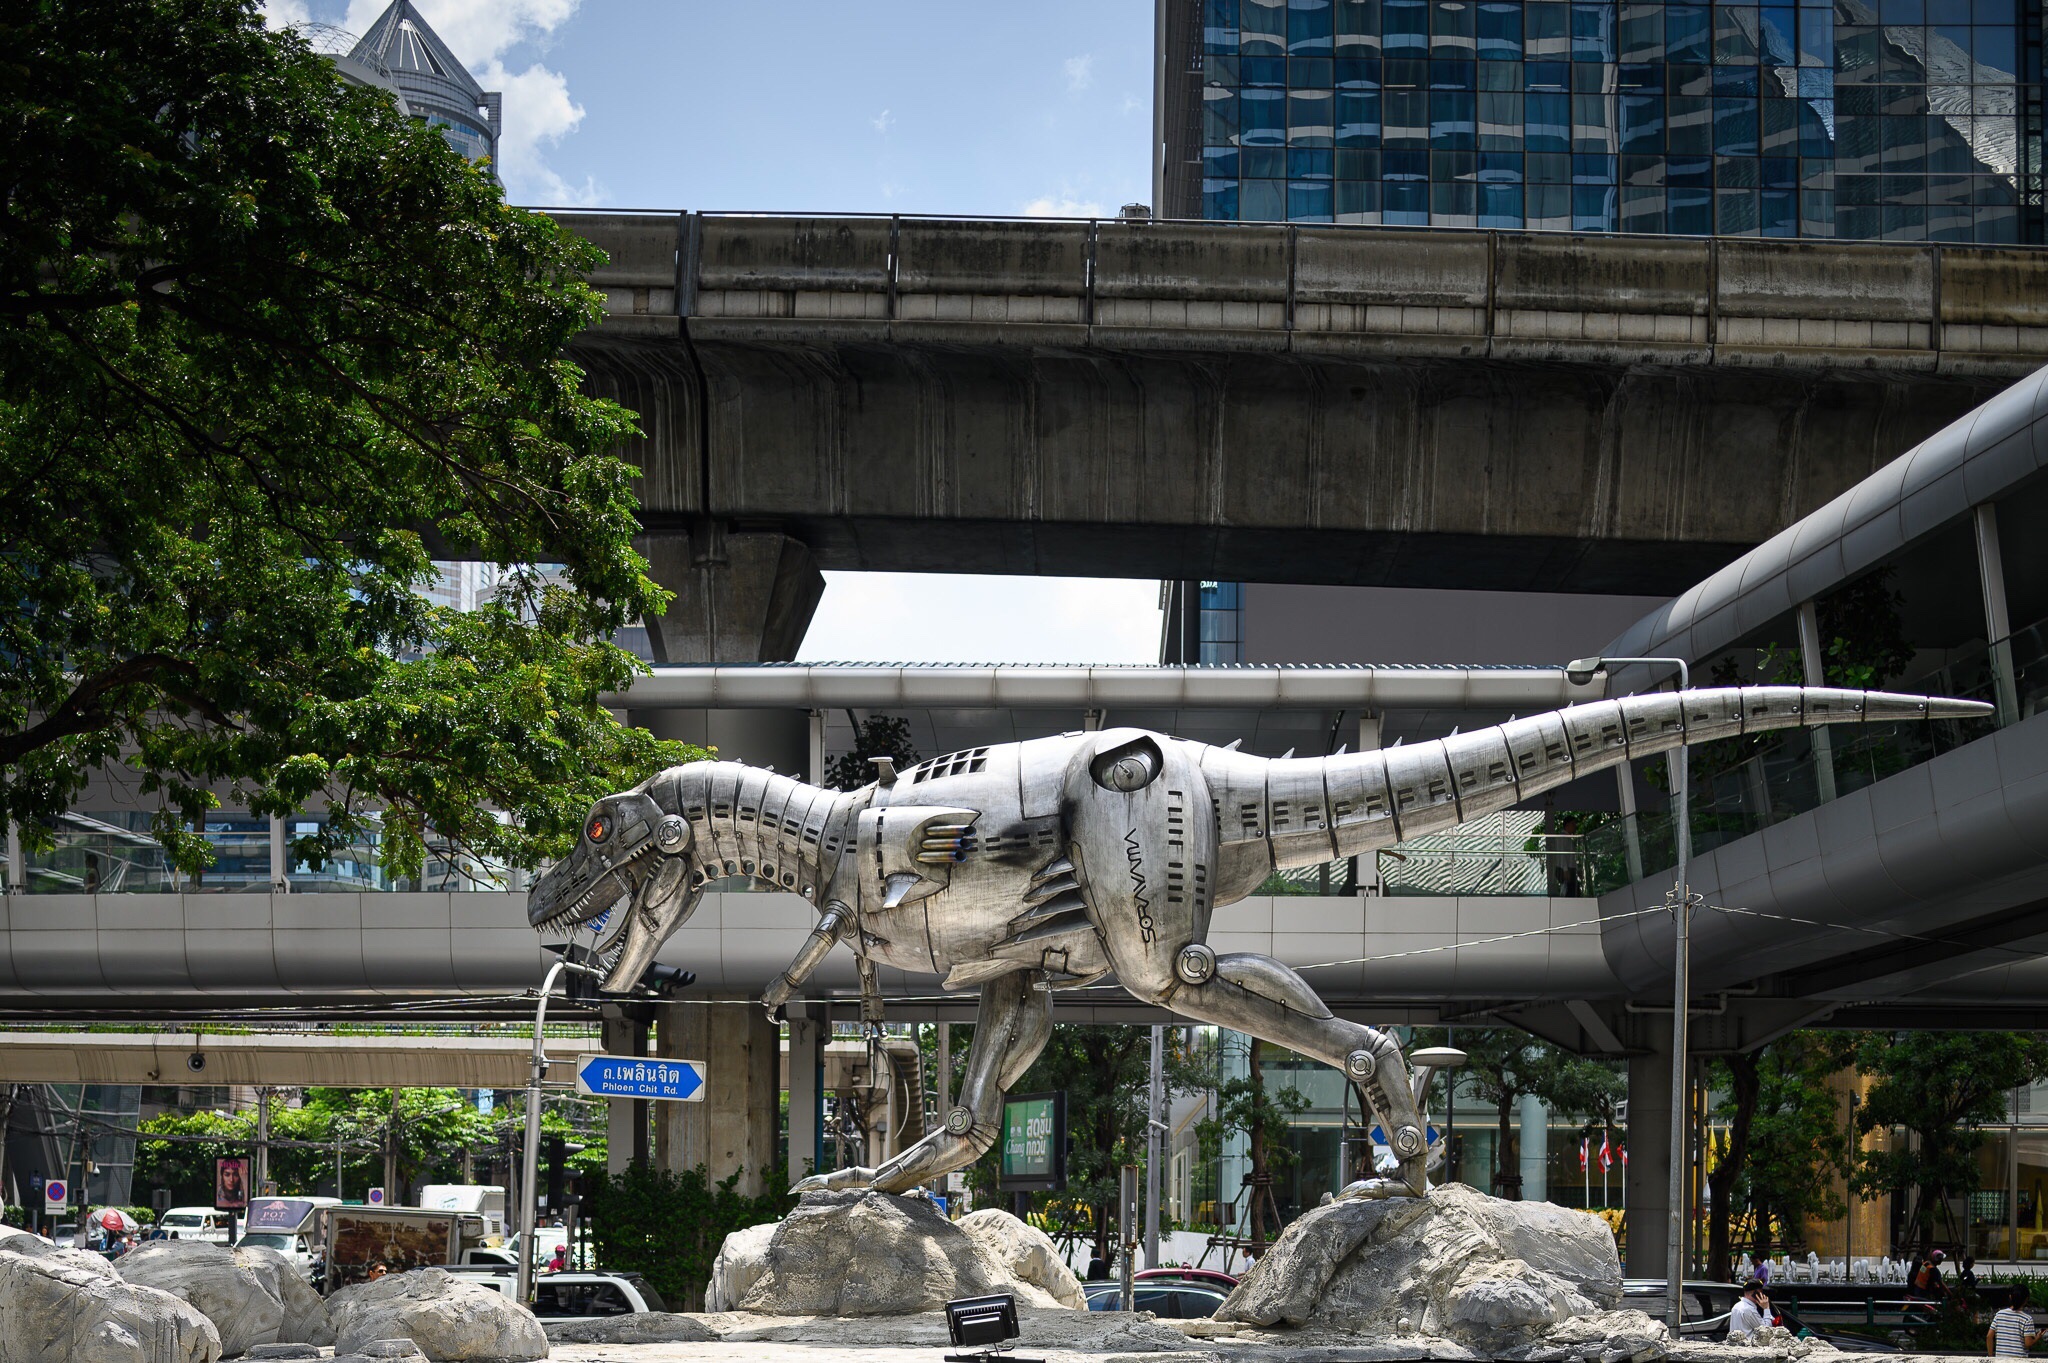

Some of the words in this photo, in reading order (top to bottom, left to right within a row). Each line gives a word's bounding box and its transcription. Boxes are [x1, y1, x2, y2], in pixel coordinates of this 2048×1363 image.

[603, 1063, 679, 1084] ถ.เพลินจิต
[602, 1082, 634, 1092] Phloen
[639, 1084, 658, 1094] Chit
[664, 1086, 678, 1095] Rd.
[1026, 1104, 1052, 1138] สดชื่น
[1006, 1139, 1025, 1157] Chang
